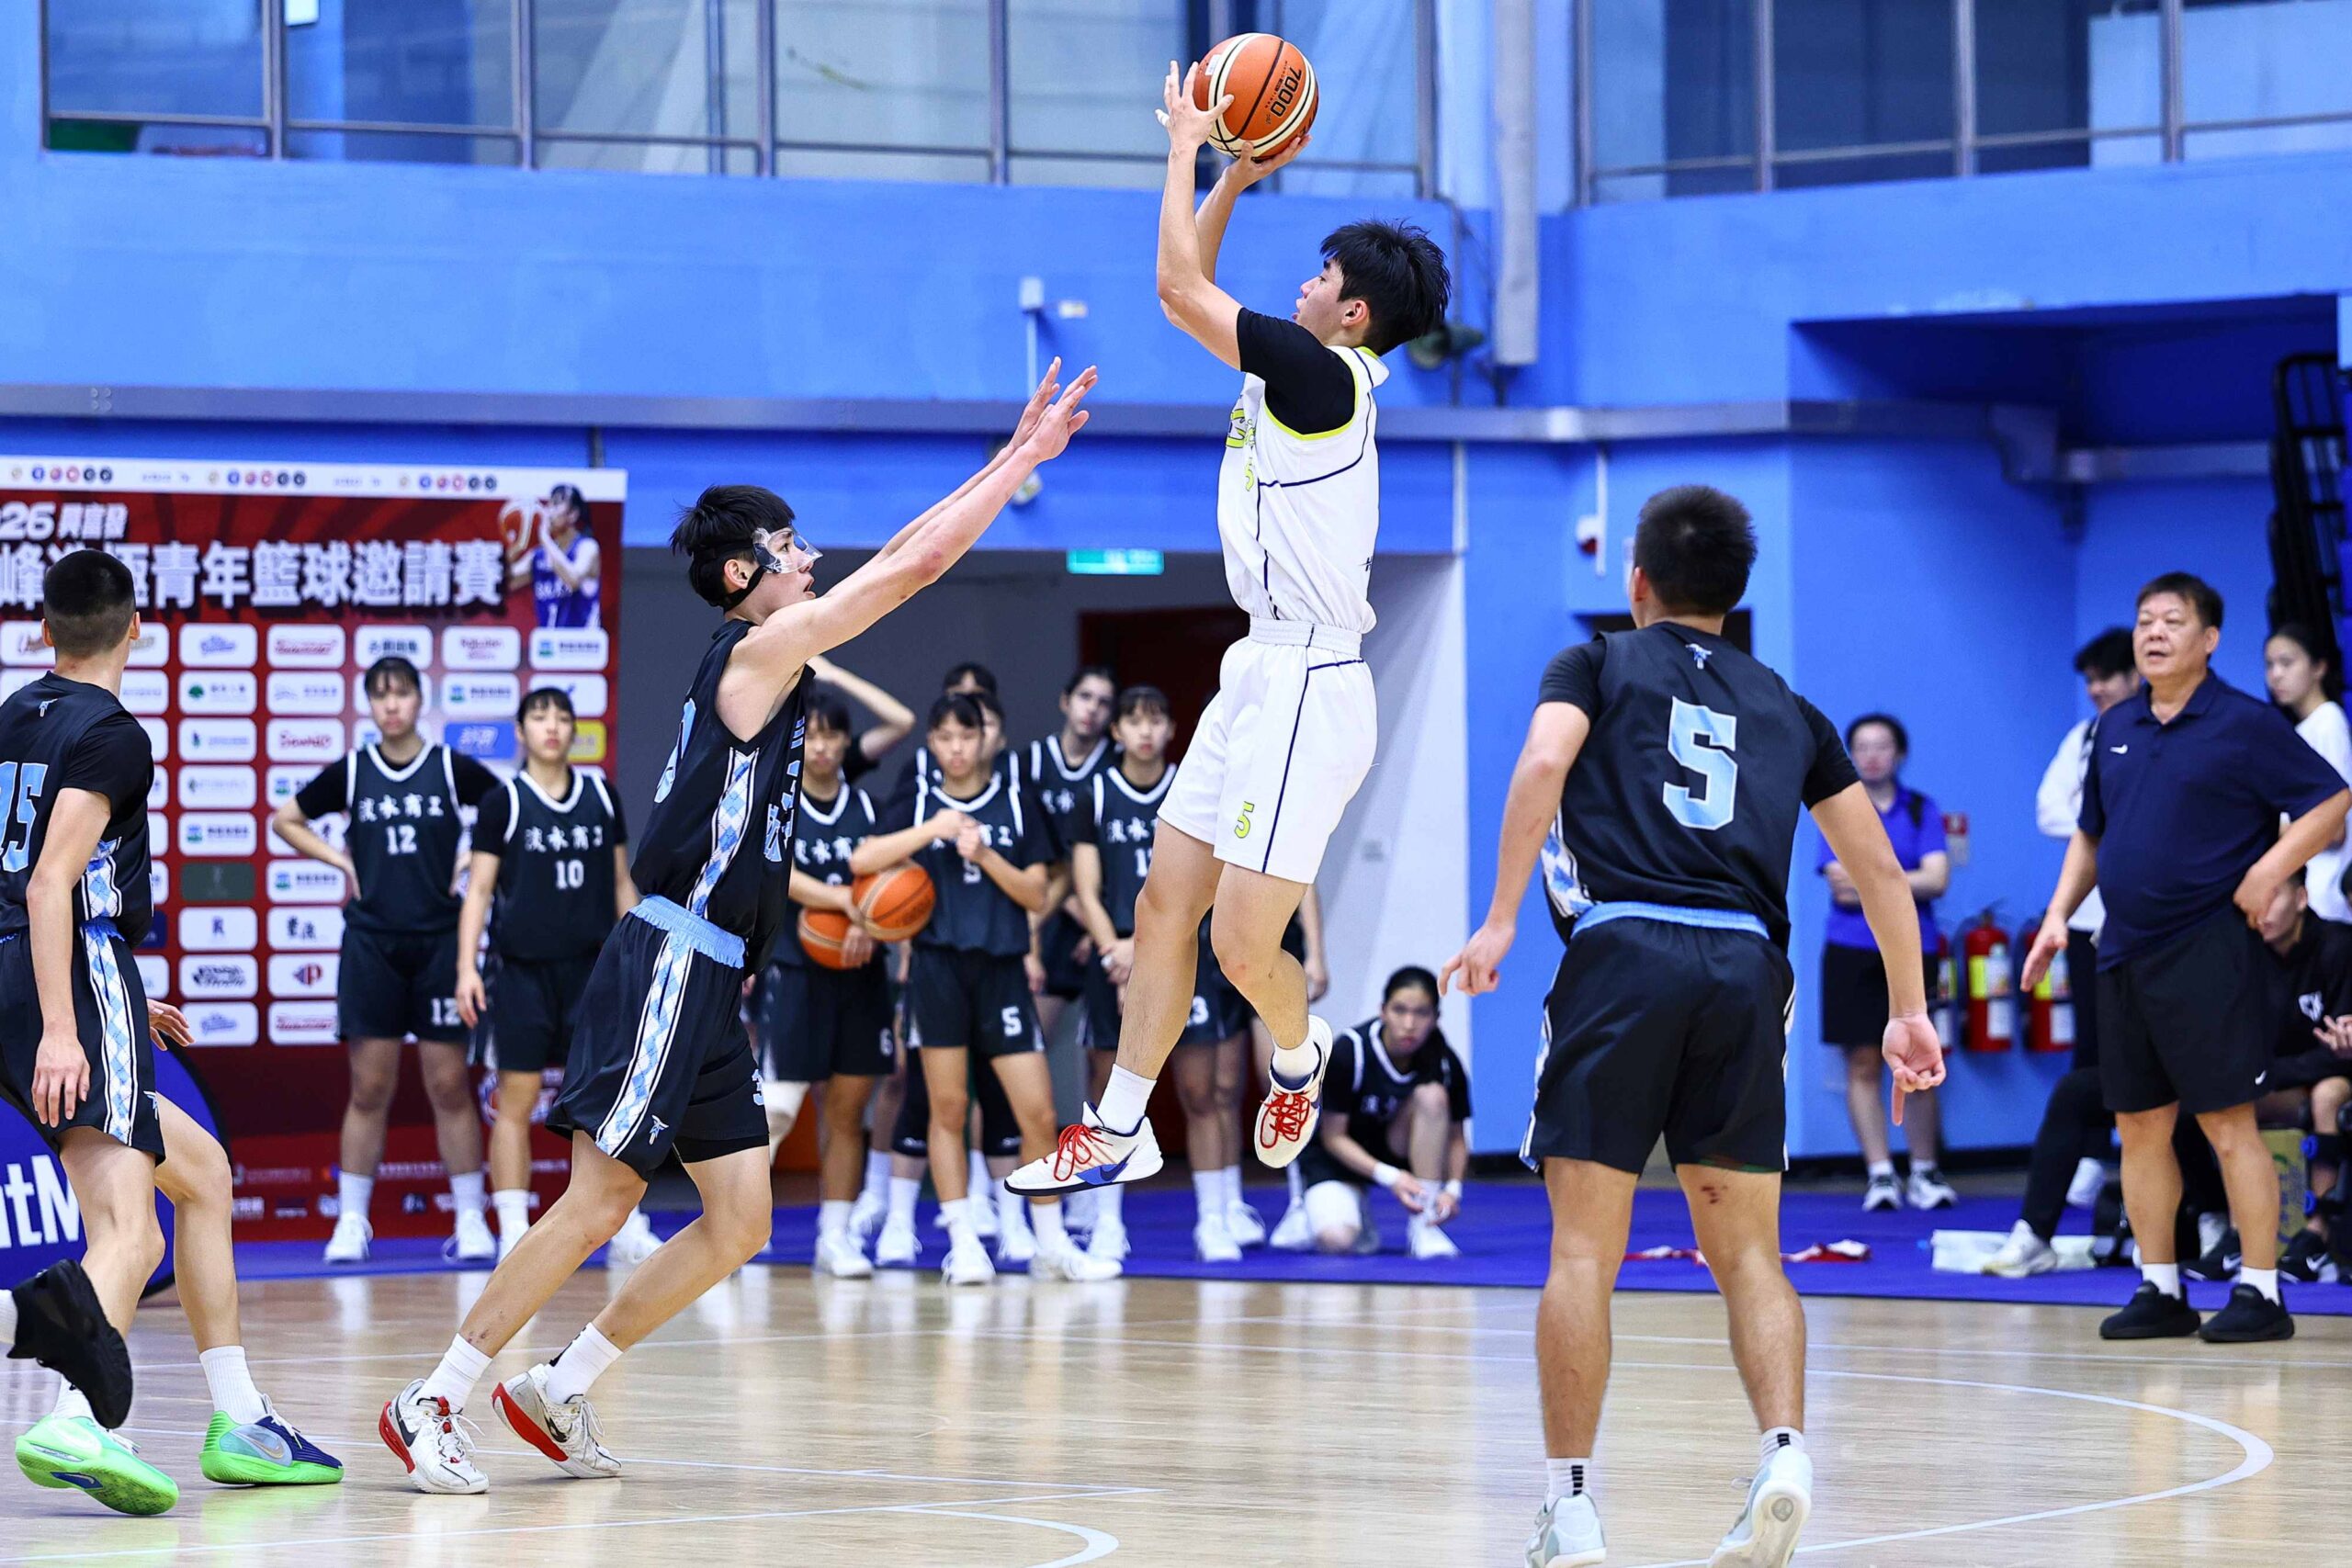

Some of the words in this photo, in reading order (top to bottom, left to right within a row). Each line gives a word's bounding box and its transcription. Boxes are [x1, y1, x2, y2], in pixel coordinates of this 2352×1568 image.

[1270, 67, 1302, 117] 7000
[0, 538, 503, 610] 峰極青年籃球邀請賽
[1663, 695, 1737, 830] 5
[357, 792, 445, 824] 淡水商工
[1234, 800, 1255, 839] 5
[386, 824, 418, 856] 12
[555, 859, 585, 890] 10
[1134, 847, 1153, 877] 1
[430, 997, 462, 1027] 12
[1001, 1006, 1023, 1037] 5
[1186, 995, 1210, 1027] 3
[879, 1027, 894, 1056] 6
[0, 1154, 81, 1249] tM
